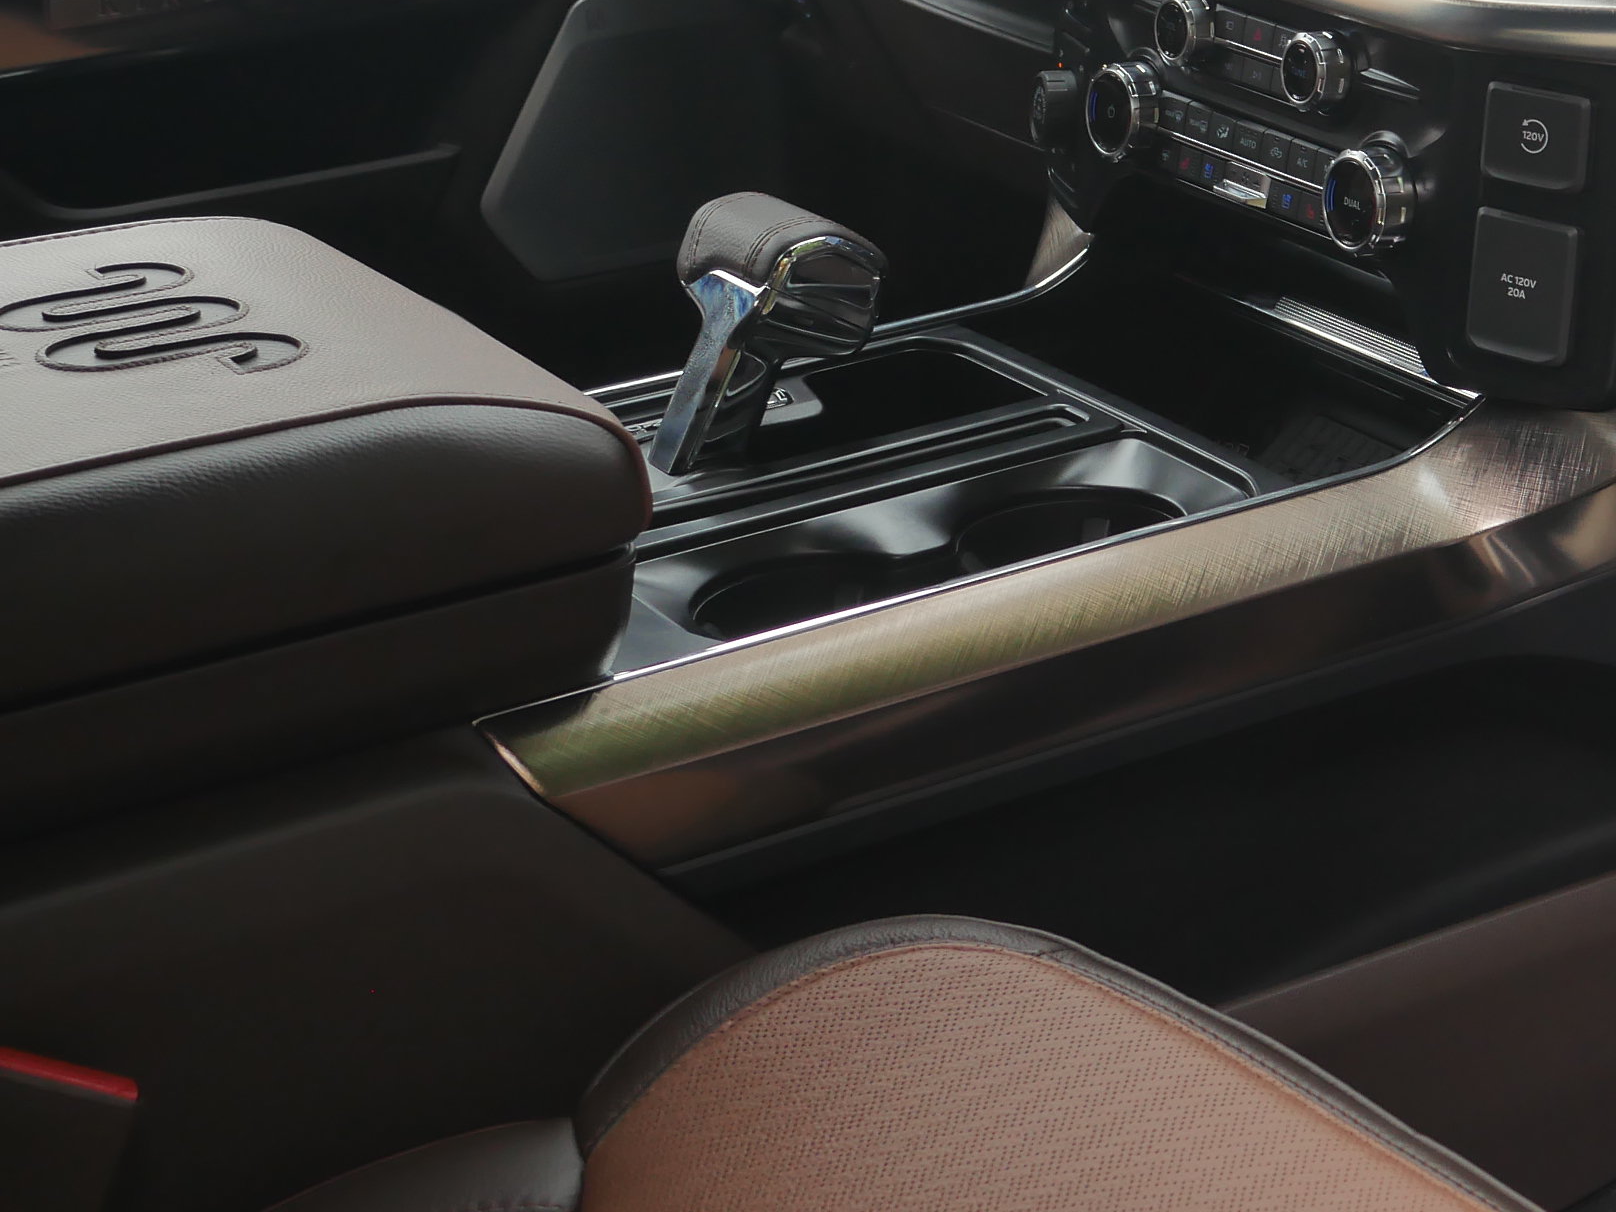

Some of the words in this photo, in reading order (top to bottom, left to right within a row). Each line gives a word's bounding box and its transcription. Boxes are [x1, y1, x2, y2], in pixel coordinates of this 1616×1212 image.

[1522, 130, 1545, 143] 120V
[1240, 138, 1257, 150] AUTO
[1344, 196, 1361, 211] DUAL
[1500, 273, 1513, 284] AC
[1515, 276, 1537, 289] 120V
[1507, 287, 1526, 300] 20A
